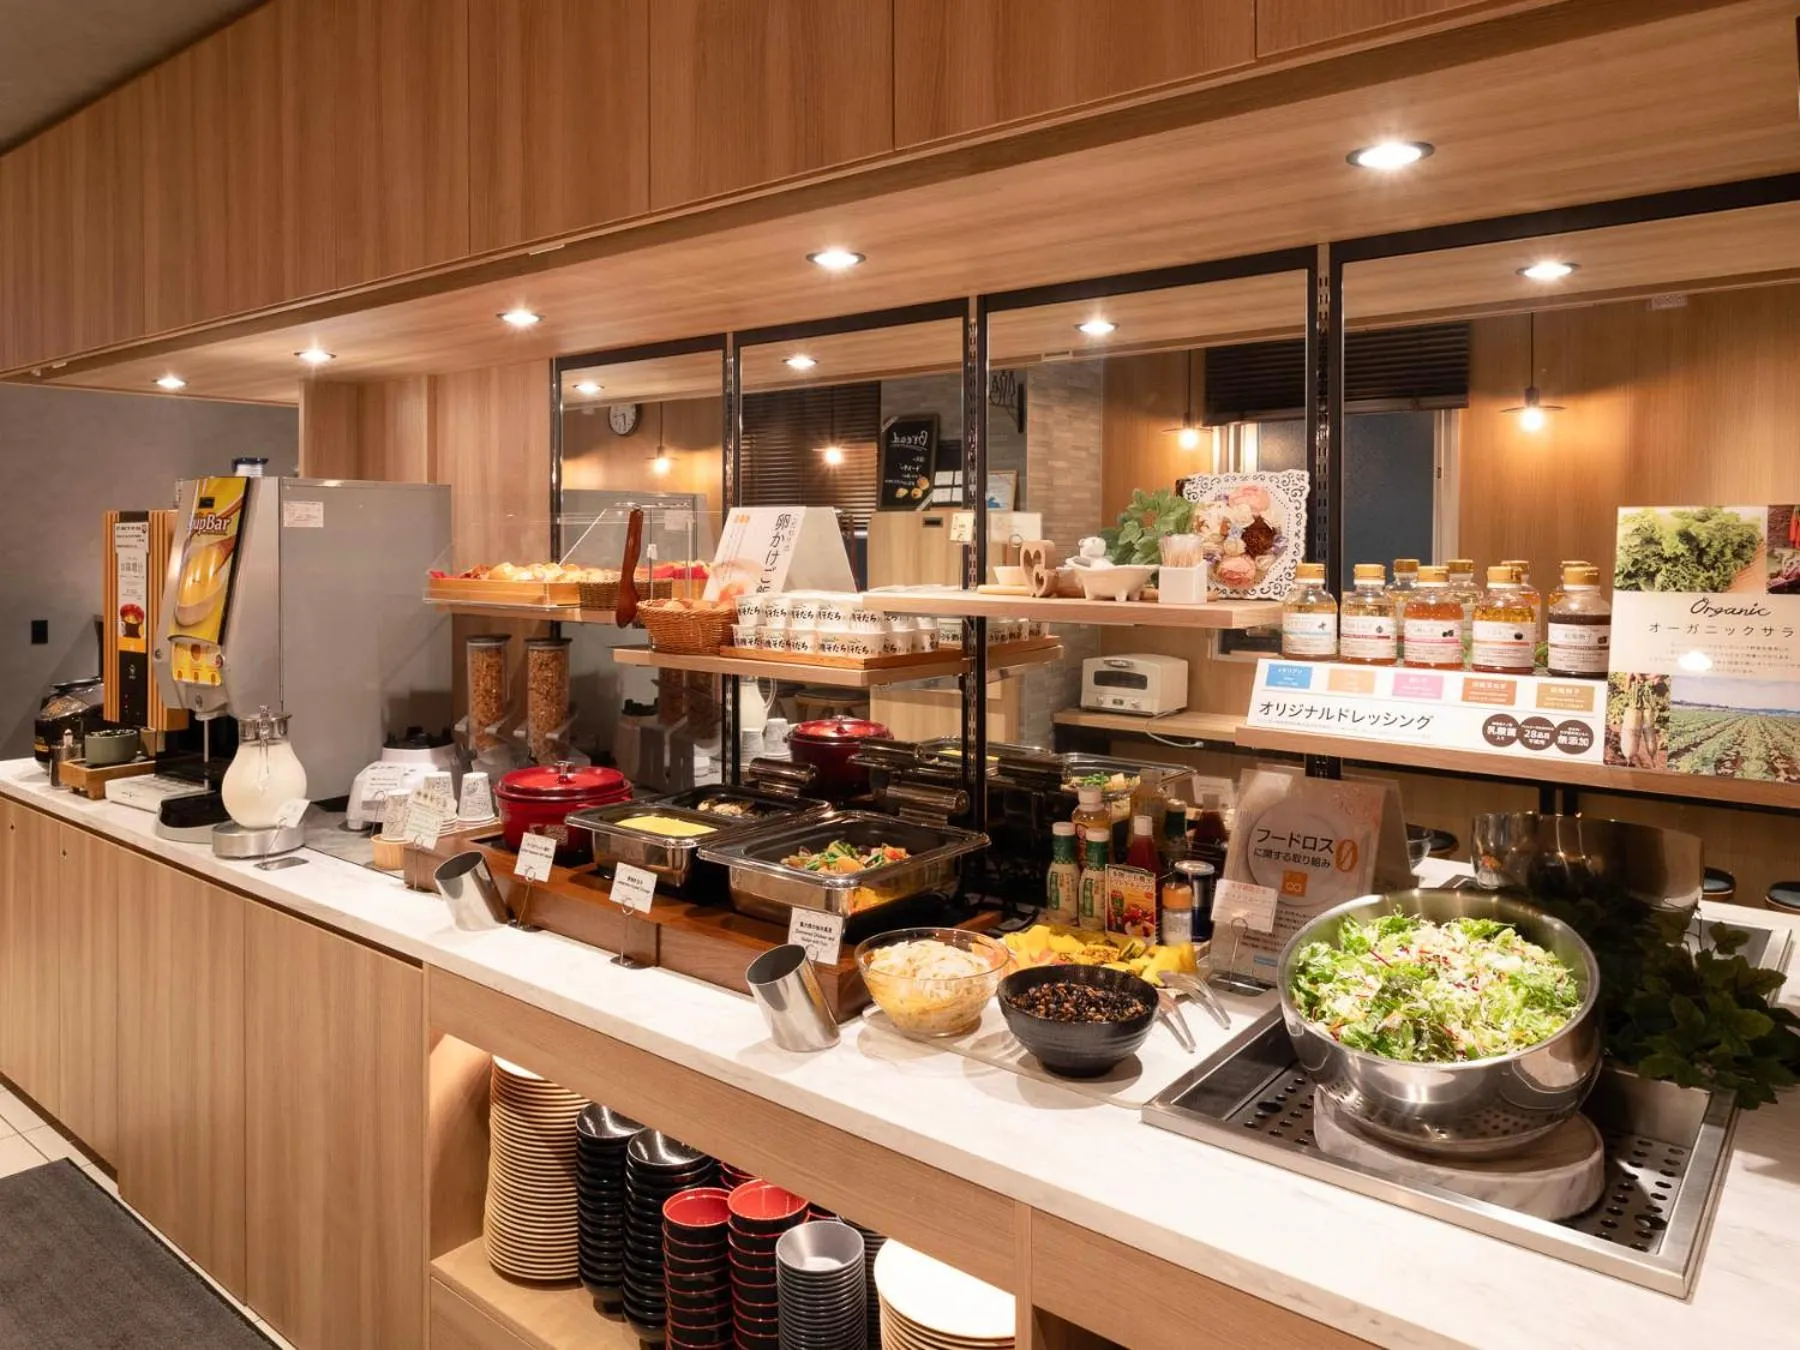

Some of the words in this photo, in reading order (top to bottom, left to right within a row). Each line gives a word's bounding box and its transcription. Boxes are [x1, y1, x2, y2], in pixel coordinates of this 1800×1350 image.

[1690, 597, 1771, 617] Organic
[1649, 622, 1795, 638] オーガニックサラ
[1259, 700, 1435, 730] オリジナルドレッシング
[1256, 828, 1334, 854] フードロス
[1253, 848, 1331, 869] に関する取り組み
